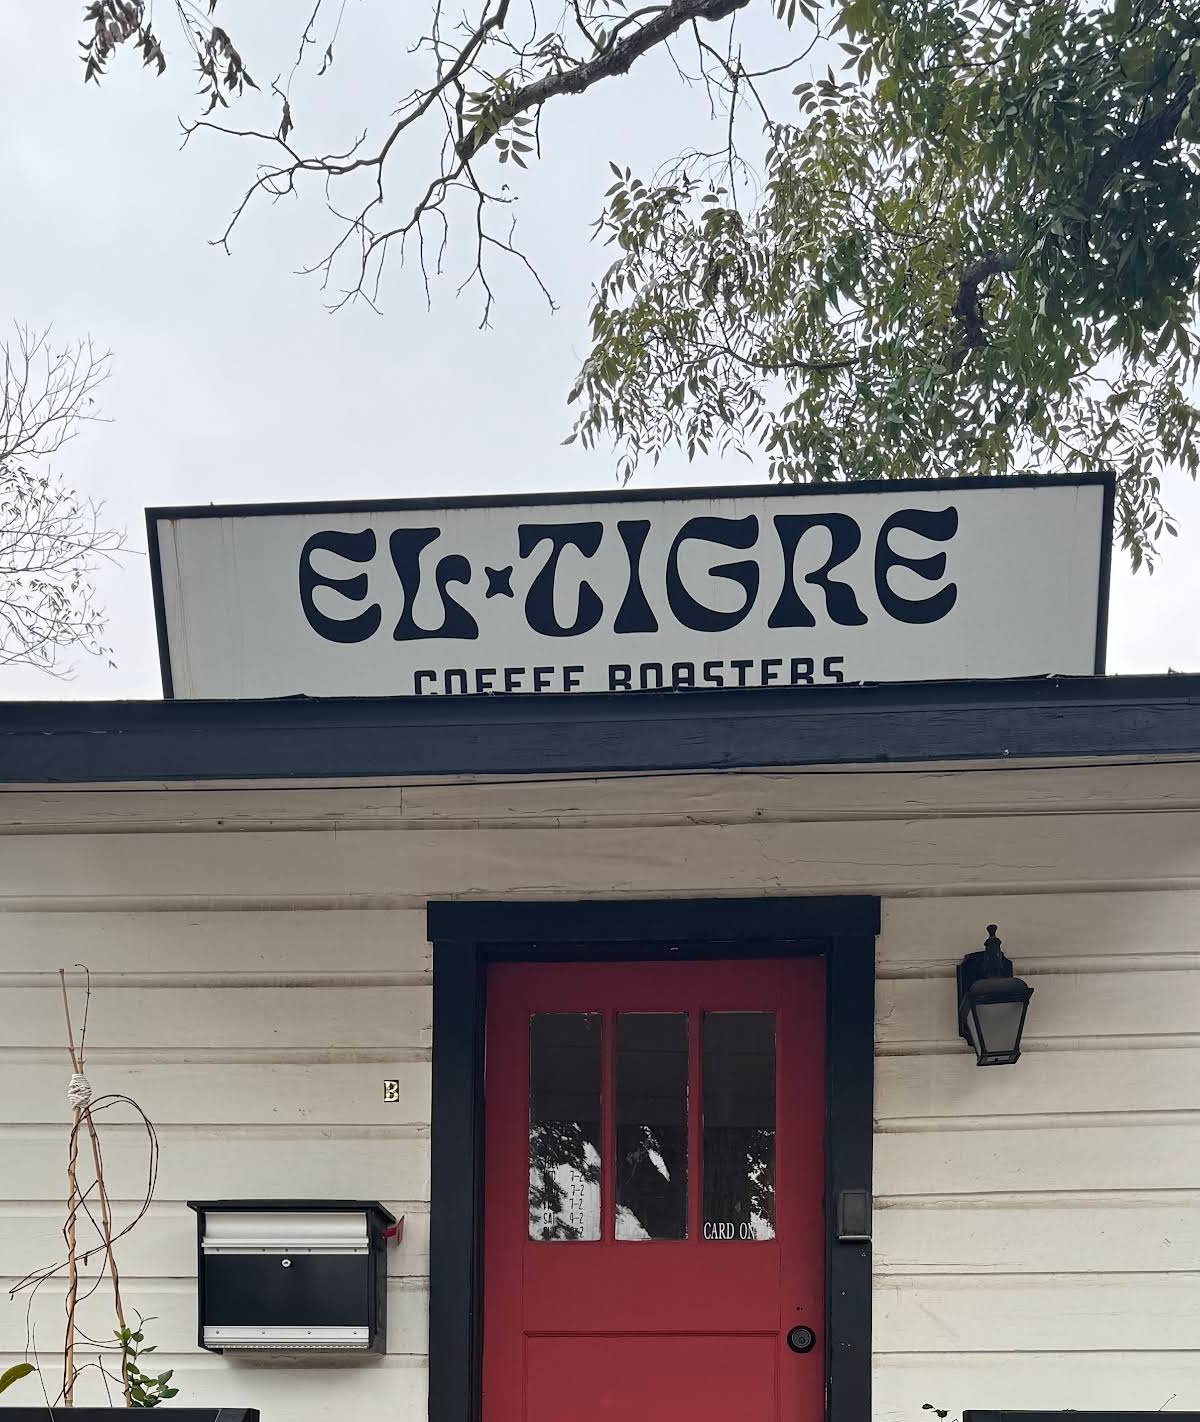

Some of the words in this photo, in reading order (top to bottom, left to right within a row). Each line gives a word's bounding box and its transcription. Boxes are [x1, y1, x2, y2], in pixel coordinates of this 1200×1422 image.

[298, 527, 480, 644] EL
[517, 506, 959, 638] TIGRE
[608, 656, 845, 691] ROASTERS
[384, 1080, 399, 1102] B
[703, 1222, 735, 1240] CARD
